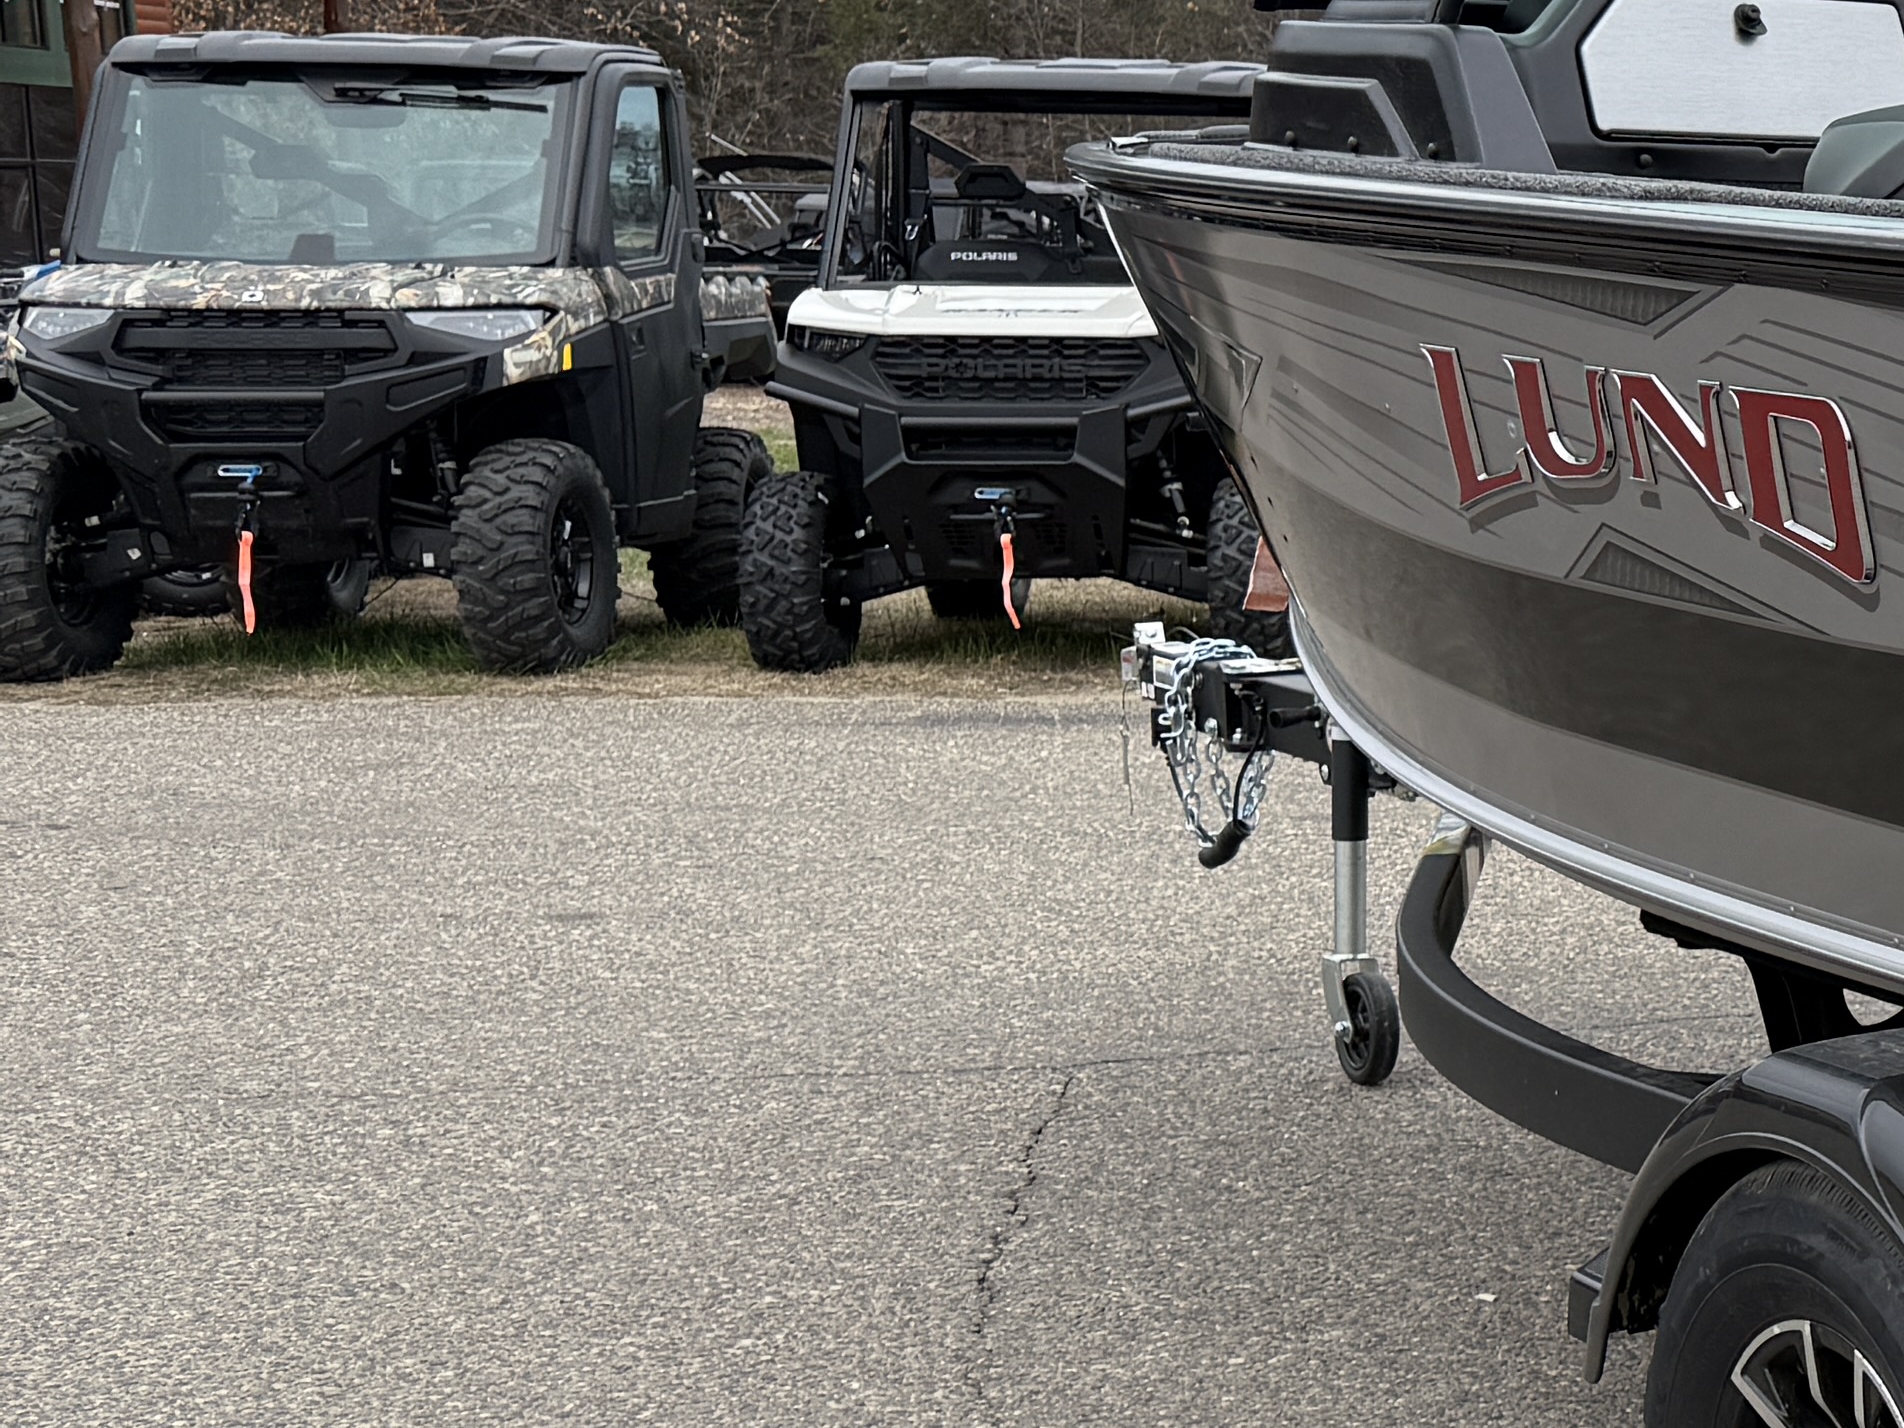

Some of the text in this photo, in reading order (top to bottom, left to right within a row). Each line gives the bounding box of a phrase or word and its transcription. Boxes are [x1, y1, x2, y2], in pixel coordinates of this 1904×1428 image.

[950, 251, 1018, 262] POLARIS
[921, 358, 1086, 379] POLARIS
[1418, 343, 1877, 585] LUND
